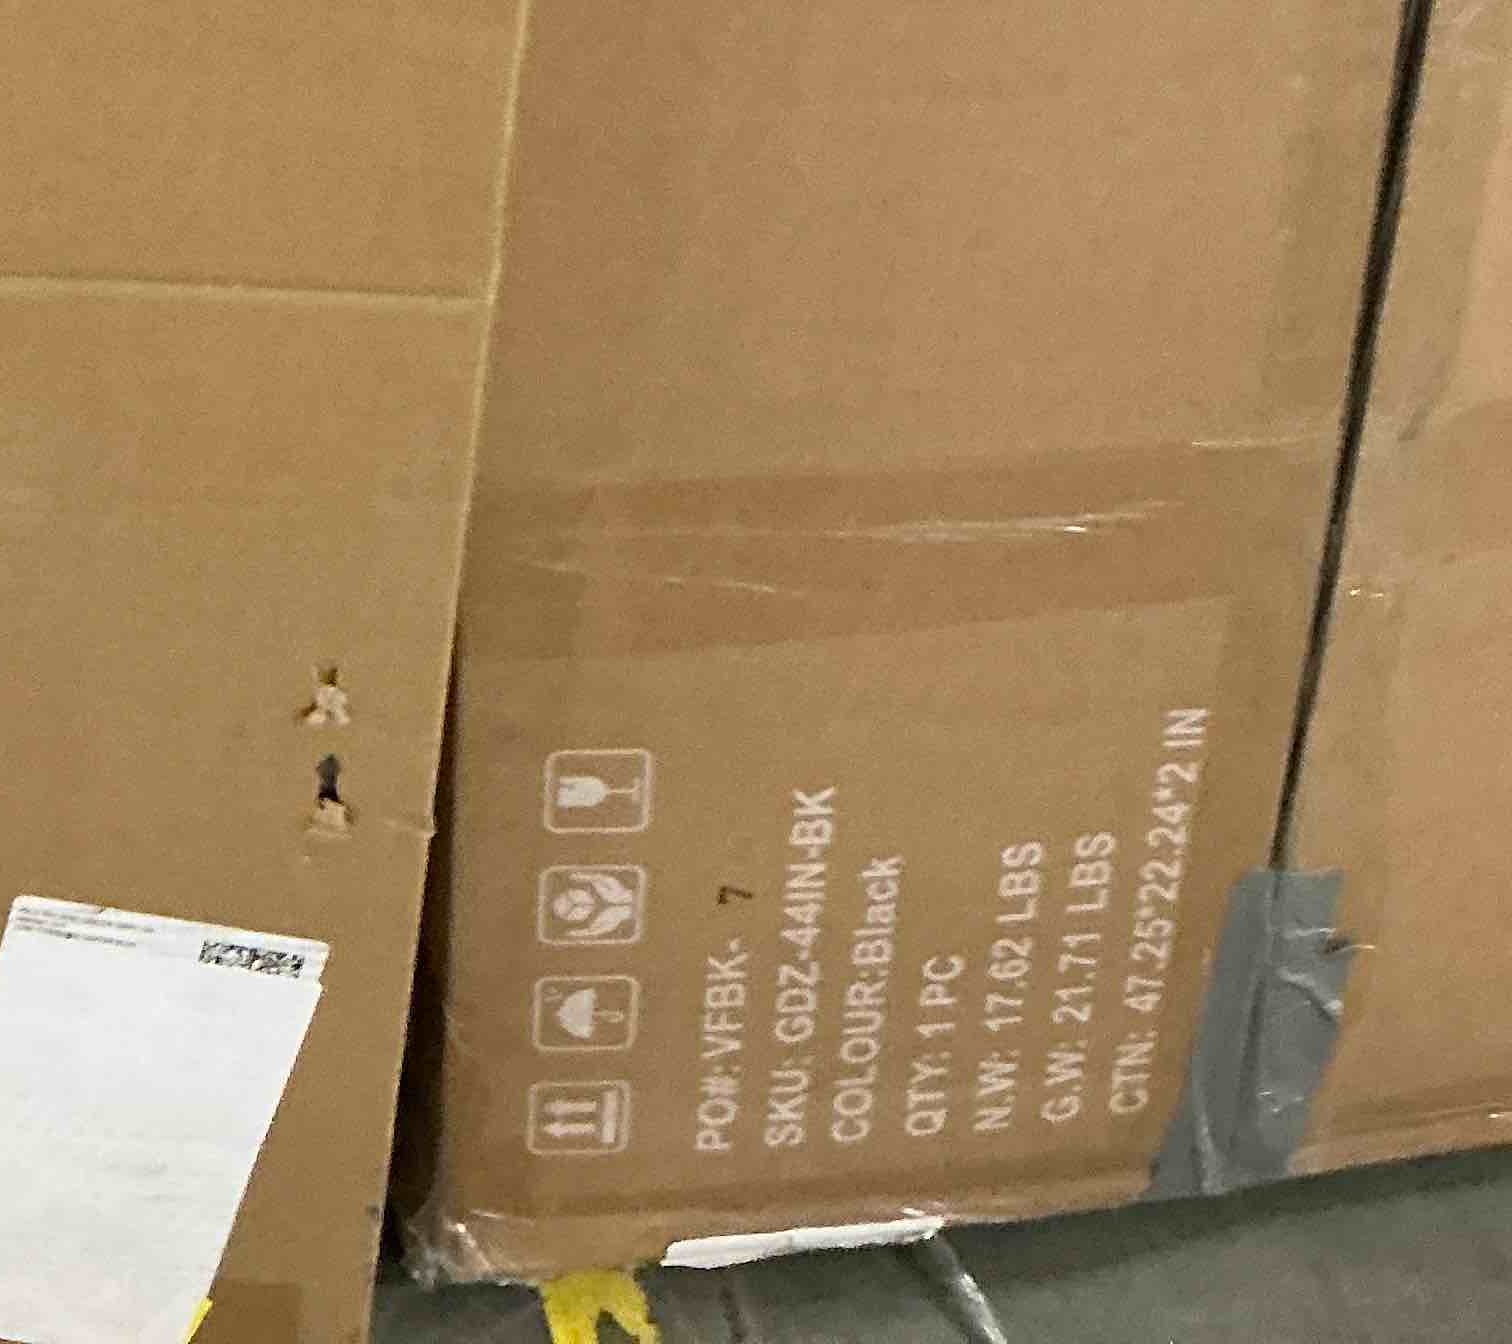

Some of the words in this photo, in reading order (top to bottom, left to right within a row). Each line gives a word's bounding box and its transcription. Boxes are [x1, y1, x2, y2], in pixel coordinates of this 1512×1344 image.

[717, 886, 755, 906] 7
[996, 842, 1045, 925] LBS
[1066, 832, 1118, 914] LBS
[1108, 1030, 1160, 1116] CTN:
[1163, 708, 1212, 749] IN
[774, 787, 838, 1046] GDZ-44IN-BK
[919, 955, 966, 1008] PC
[984, 938, 1034, 1034] 17.62
[1052, 933, 1103, 1026] 21.71
[916, 1022, 957, 1040] 1
[764, 1058, 813, 1149] SKU:
[904, 1052, 952, 1138] QTY:
[973, 1050, 1021, 1133] N.W:
[1041, 1040, 1090, 1126] G.W:
